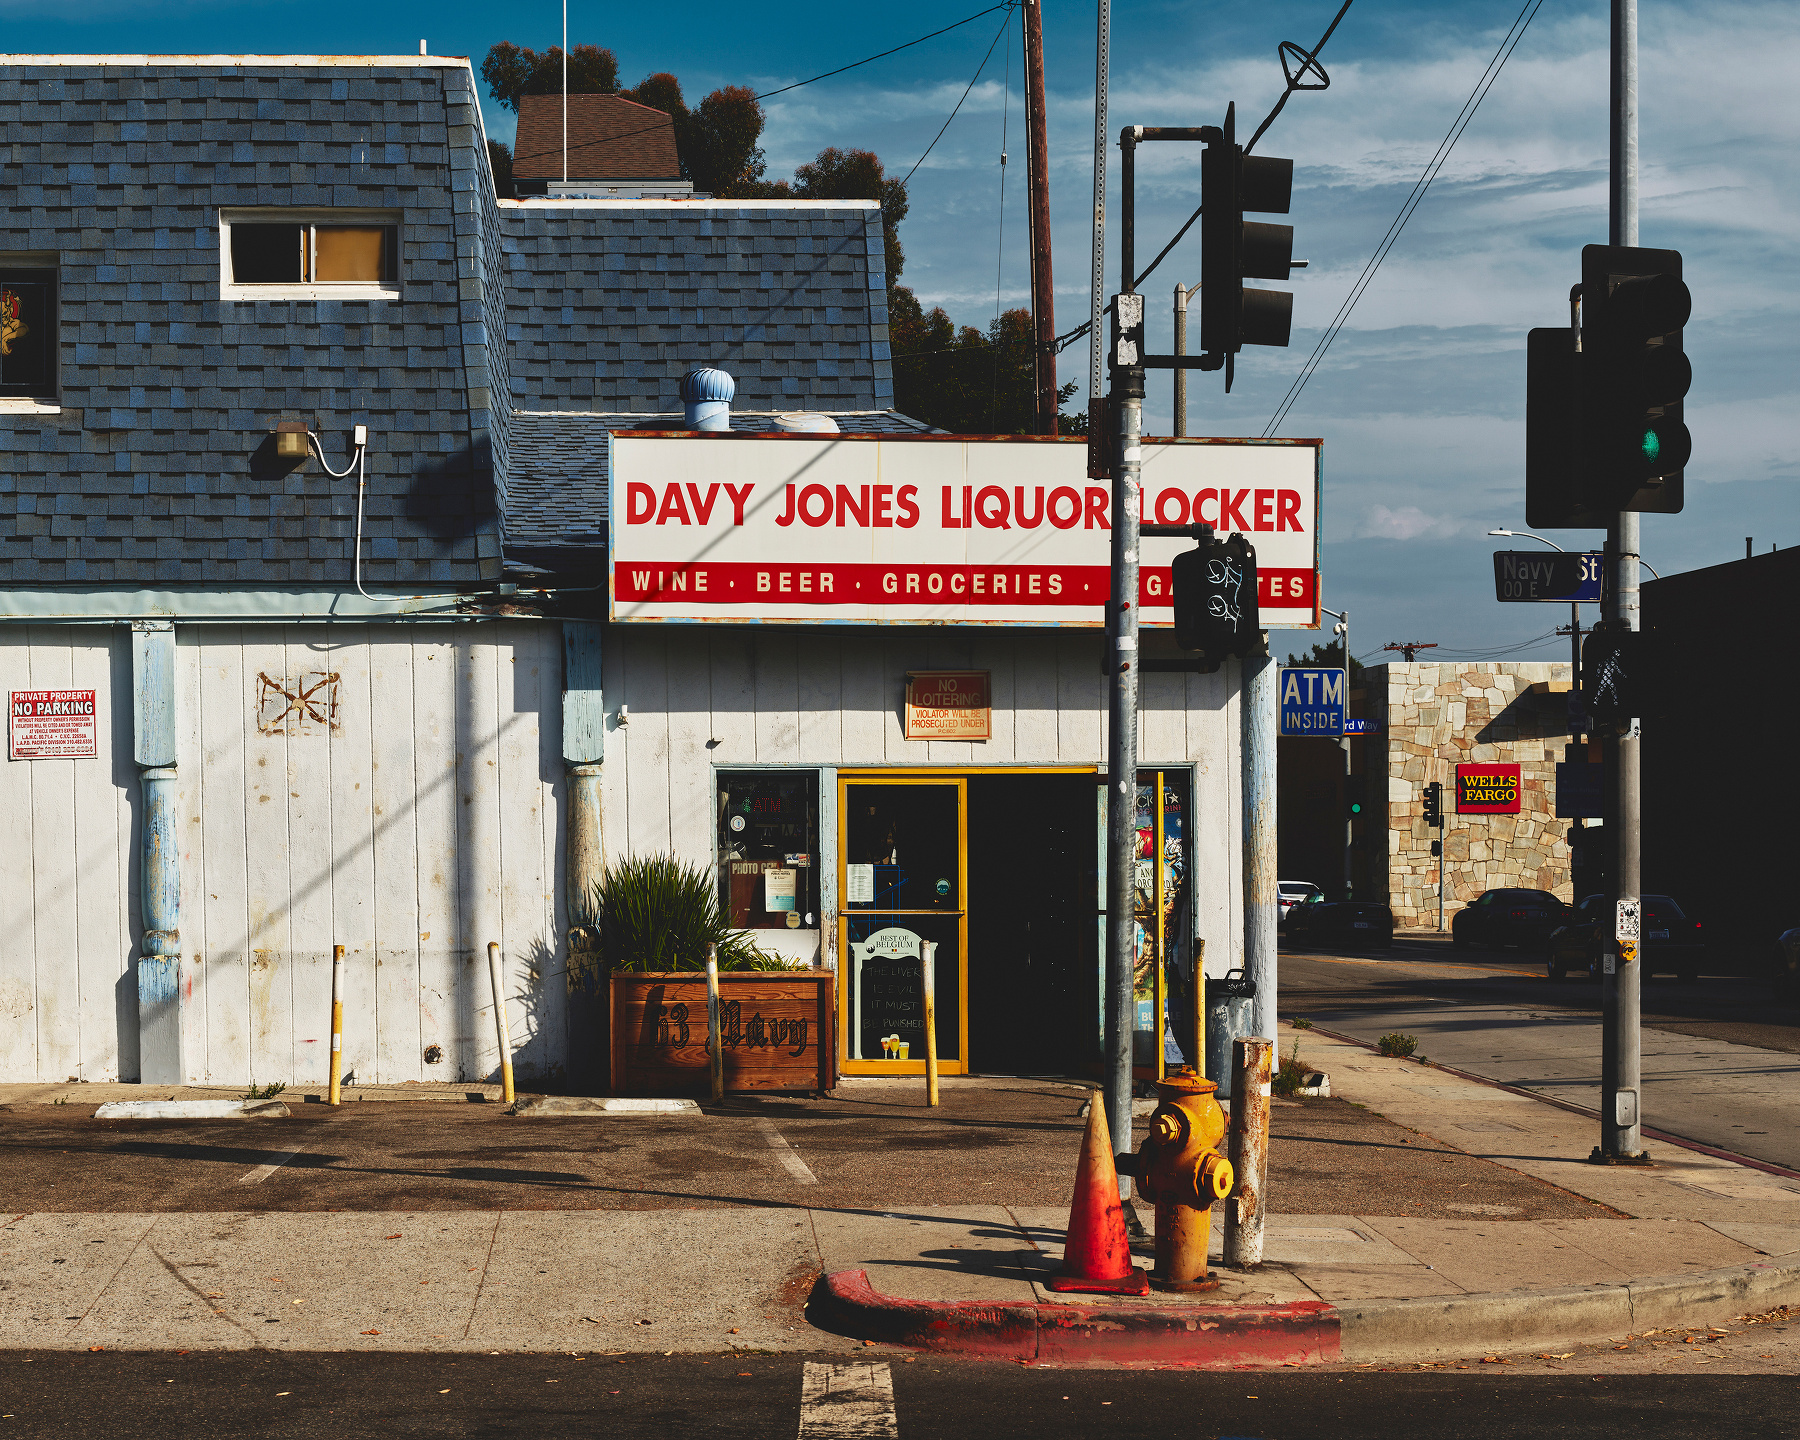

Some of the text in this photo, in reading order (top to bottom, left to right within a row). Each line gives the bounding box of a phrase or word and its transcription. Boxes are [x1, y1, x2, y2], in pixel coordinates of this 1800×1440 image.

[626, 482, 755, 527] DAVY
[774, 483, 920, 529] JONES
[941, 485, 1112, 531] LIQUOR
[1503, 556, 1598, 587] Navy St
[632, 570, 1063, 595] WINE BEER GROCERIES
[1530, 581, 1538, 598] E
[938, 678, 957, 693] NO
[1283, 673, 1343, 705] ATM
[14, 691, 93, 701] PRIVATE PROPERTY
[915, 692, 981, 706] LOITERING
[13, 700, 93, 716] NO PARKING
[915, 709, 981, 719] VIOLATOR WILL BE
[911, 719, 985, 729] PROSECUTED UNDER
[1286, 711, 1338, 729] INSIDE
[1357, 720, 1378, 732] Way
[1463, 775, 1518, 787] WELLS
[1465, 789, 1517, 801] FARGO
[753, 797, 781, 813] ATM
[732, 862, 758, 875] PHOTO
[866, 965, 921, 978] THE LIVER
[870, 1000, 919, 1011] IT MUST
[883, 1018, 924, 1028] PUNISHED
